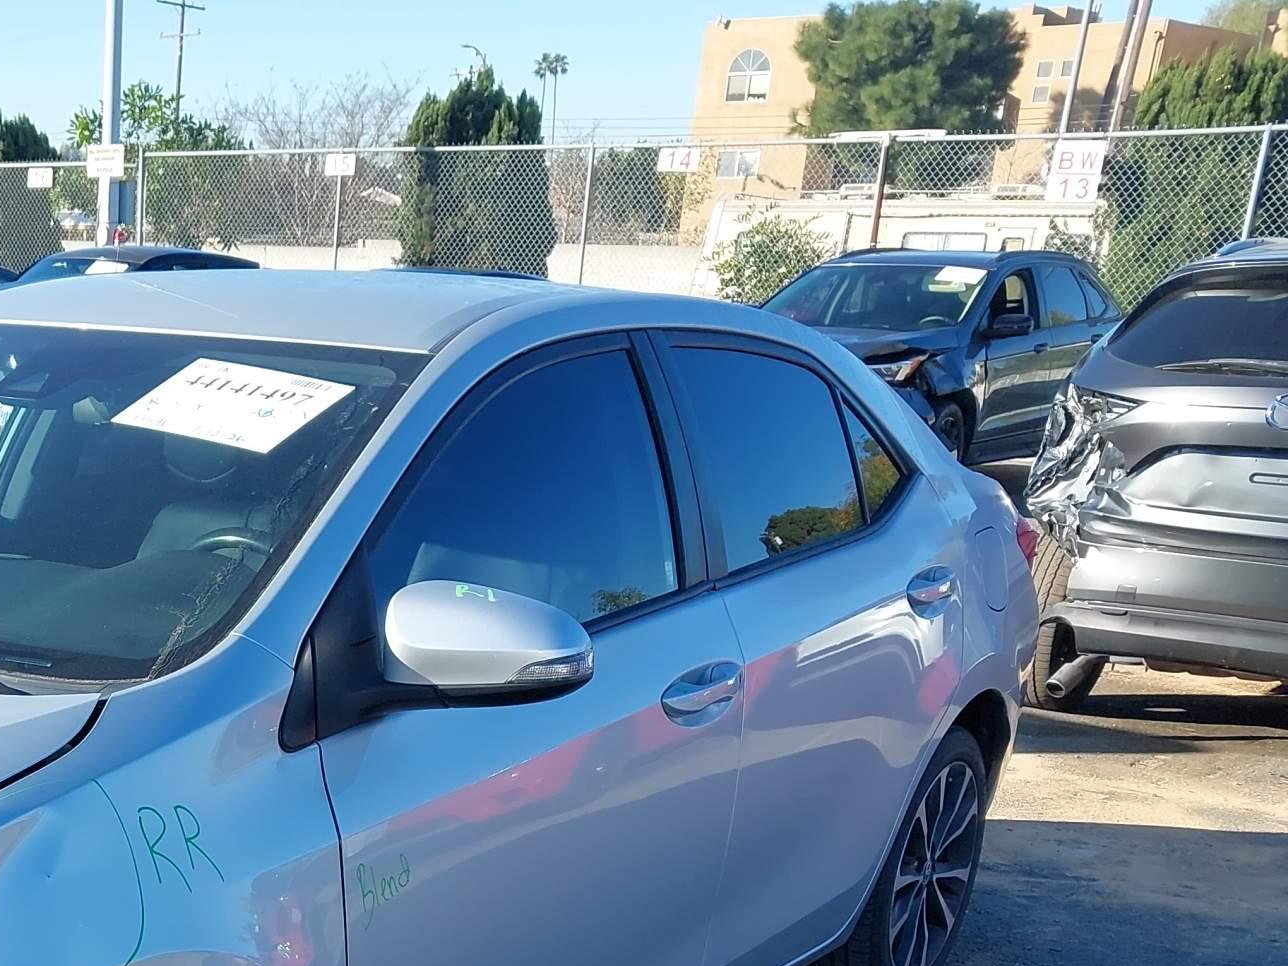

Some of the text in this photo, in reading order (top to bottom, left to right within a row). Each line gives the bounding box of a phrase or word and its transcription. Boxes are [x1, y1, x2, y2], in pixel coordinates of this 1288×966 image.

[667, 150, 692, 169] 14
[1059, 178, 1089, 199] 13
[185, 374, 316, 407] 44141497
[137, 804, 225, 893] RR
